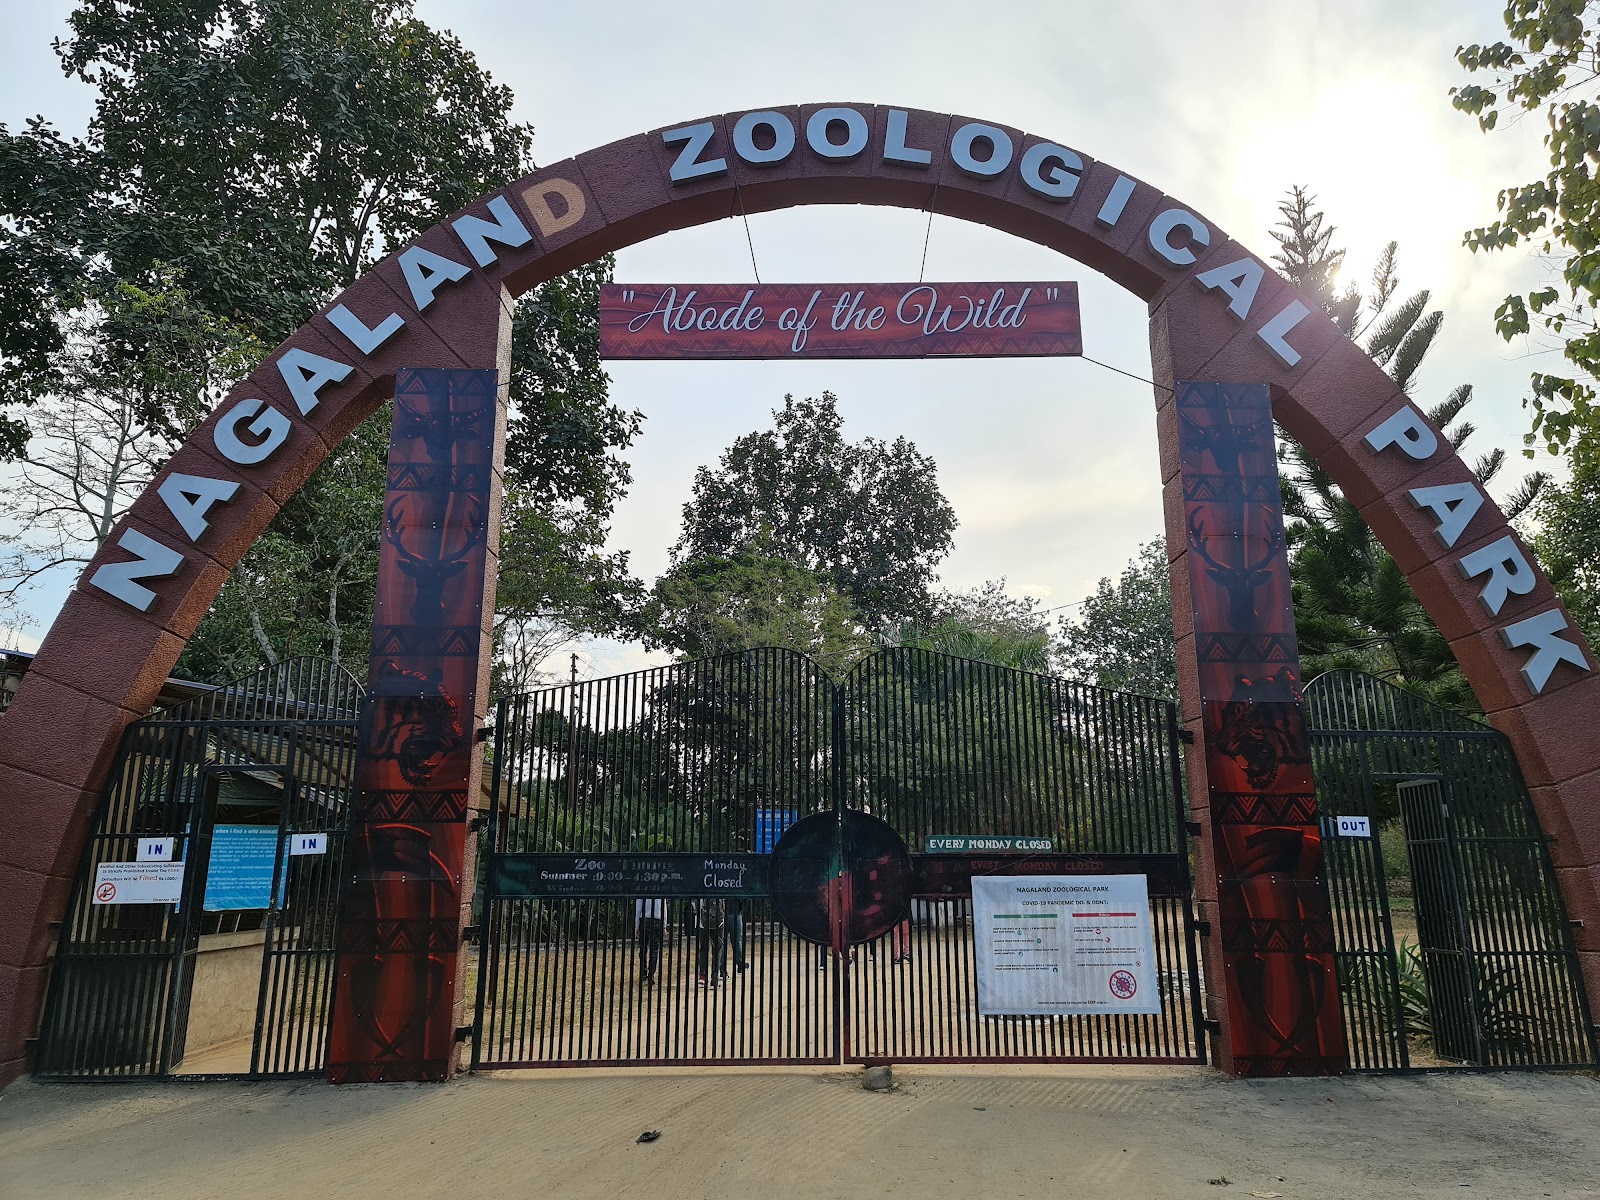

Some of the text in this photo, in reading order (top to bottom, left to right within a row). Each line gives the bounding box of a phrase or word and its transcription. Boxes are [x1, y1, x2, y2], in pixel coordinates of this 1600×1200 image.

[778, 289, 822, 353] of
[831, 290, 887, 331] the
[90, 106, 1590, 694] NAGALAND ZOOLOGICAL PARK
[1341, 821, 1366, 832] OUT
[147, 844, 163, 855] IN
[302, 838, 317, 849] IN
[929, 838, 1052, 850] EVERY MONDAY CLOSED
[574, 858, 606, 871] Zoo
[704, 859, 747, 875] Monday
[970, 860, 1000, 871] EVERY
[1013, 861, 1058, 871] MONDAY
[1064, 861, 1105, 871] CLOSED
[540, 870, 588, 880] Summer
[703, 874, 743, 888] Closed
